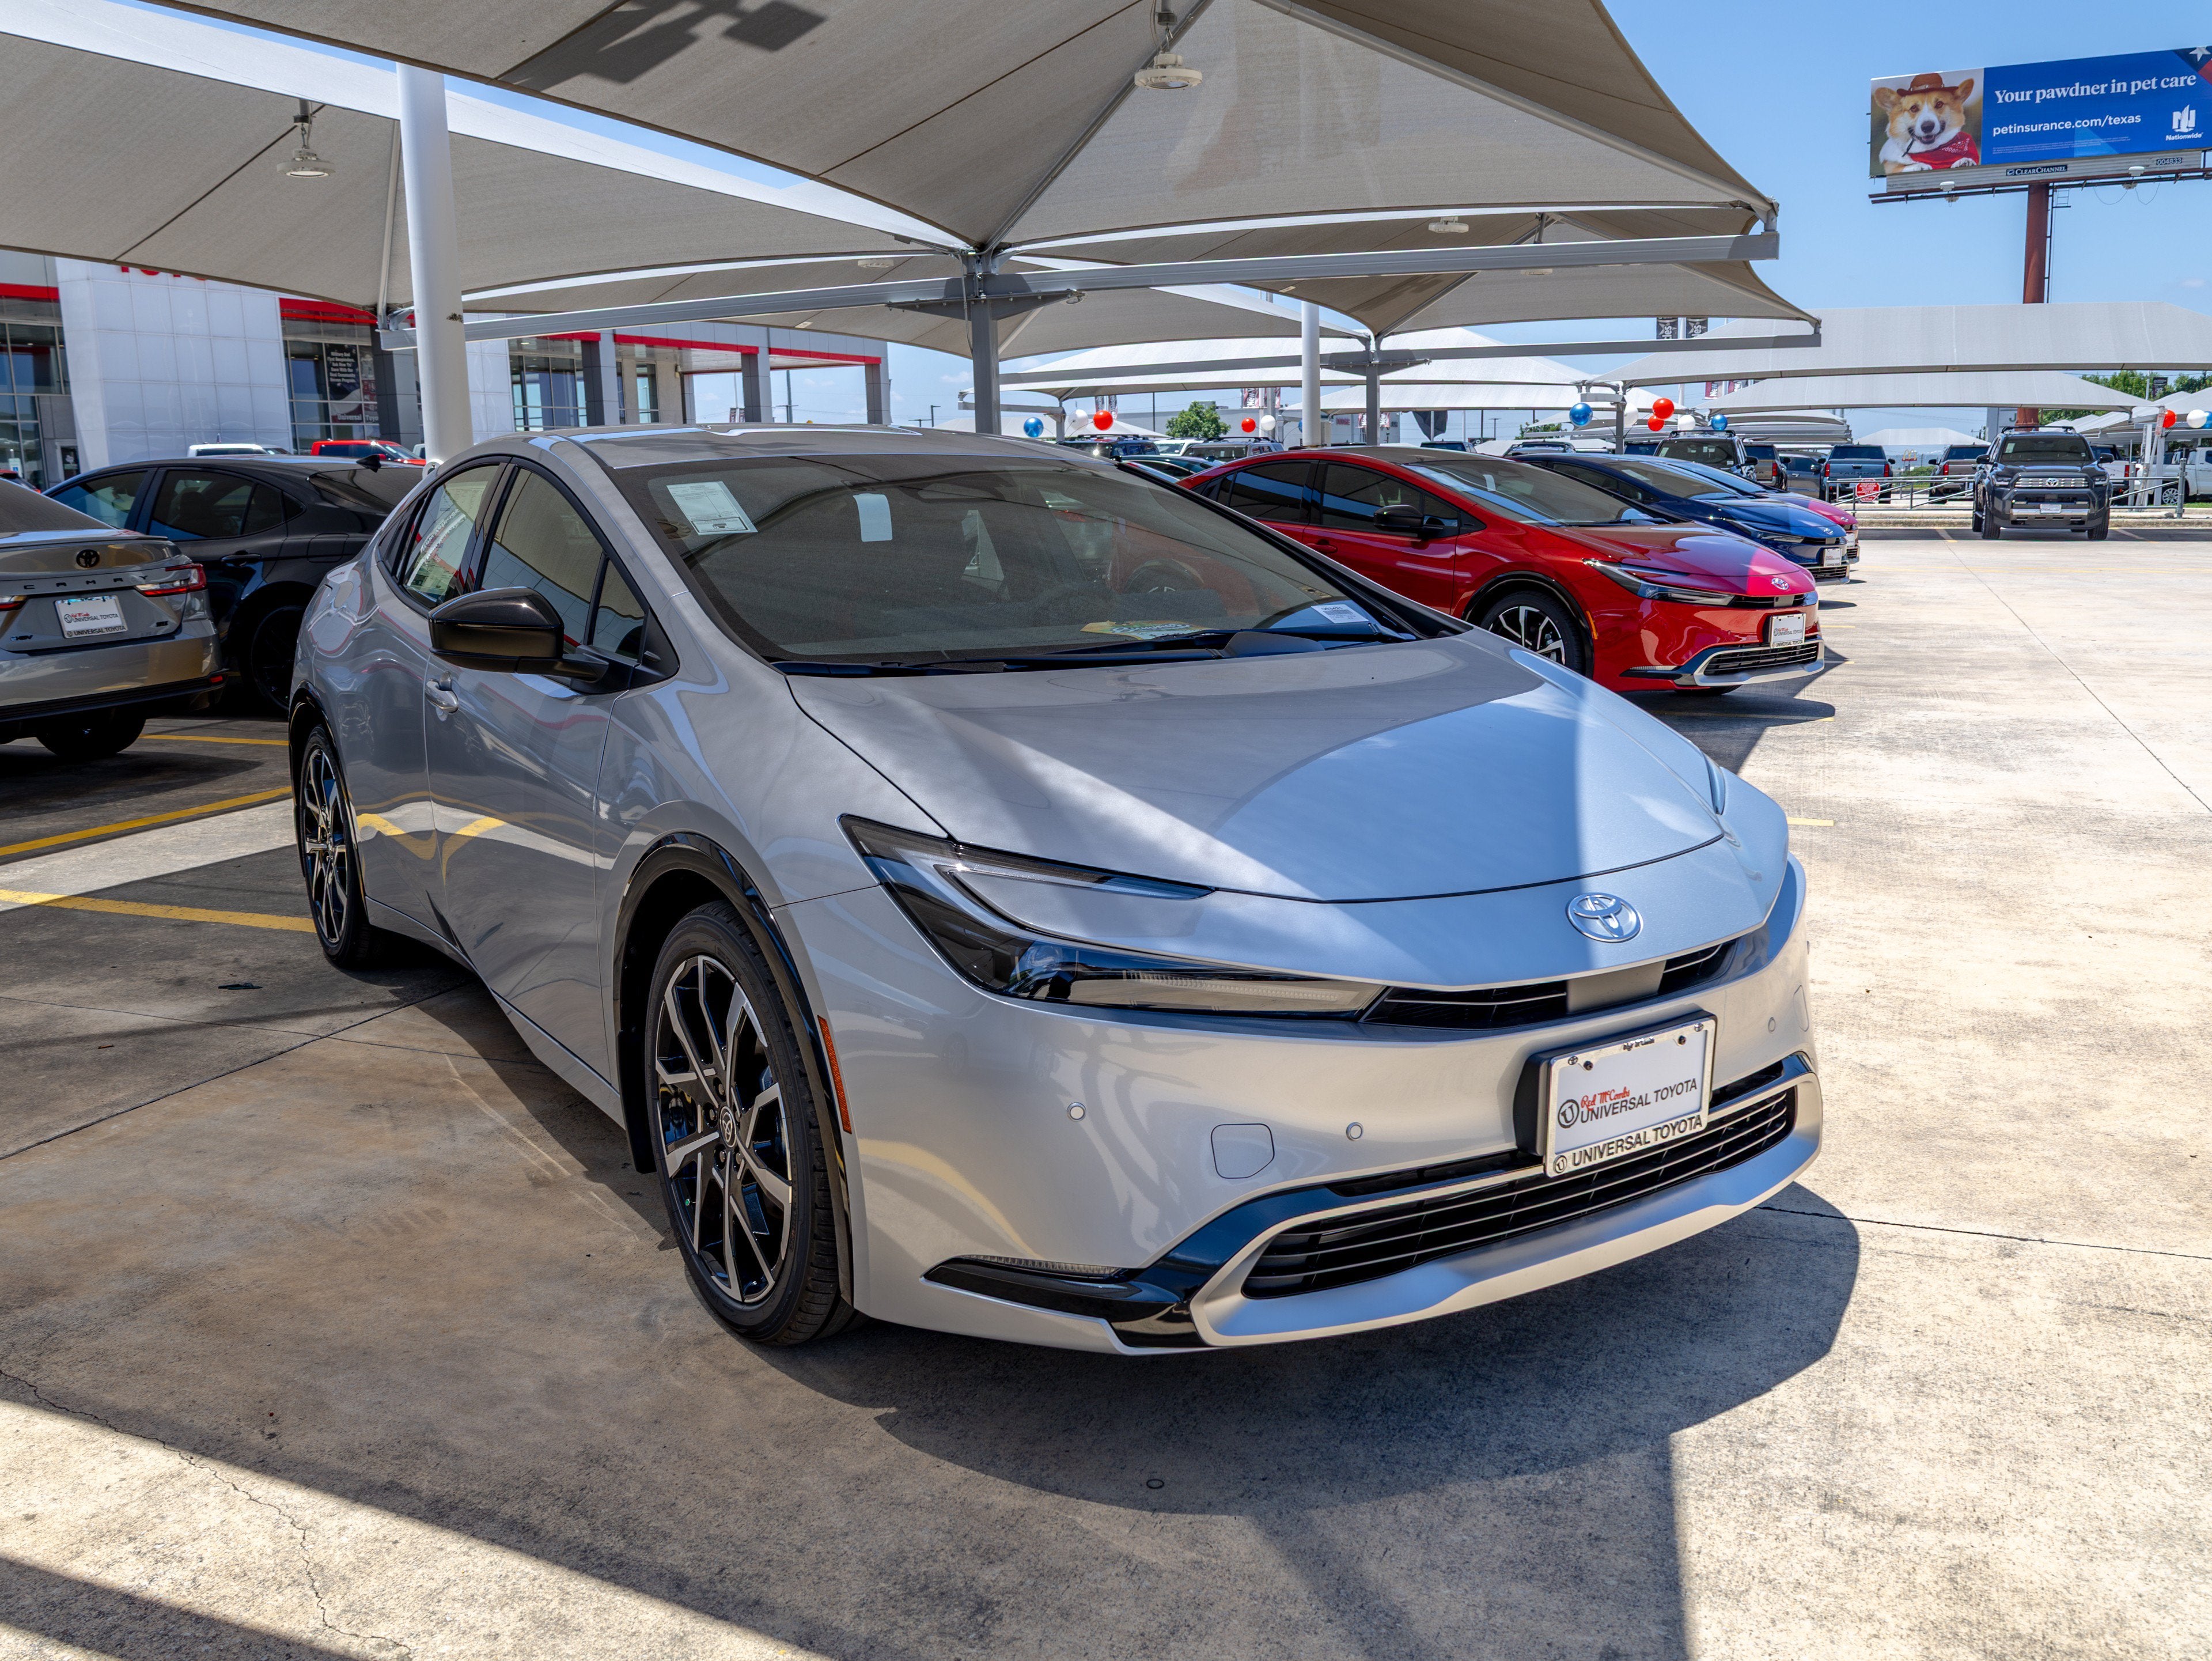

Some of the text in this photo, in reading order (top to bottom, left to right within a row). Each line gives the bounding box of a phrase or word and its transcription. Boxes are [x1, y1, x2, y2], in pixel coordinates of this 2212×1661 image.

[1995, 74, 2196, 104] Your pawdner in pet care
[1993, 115, 2142, 137] petinsurance.com/texas
[2165, 133, 2203, 141] Nationwide
[2157, 157, 2182, 165] 004833
[24, 576, 148, 590] CAMRY
[74, 627, 104, 635] UNIVERSAL
[1581, 1087, 1630, 1111] Red McCombs
[1581, 1078, 1697, 1123] UNIVERSAL TOYOTA
[1572, 1115, 1702, 1166] UNIVERSAL TOYOTA
